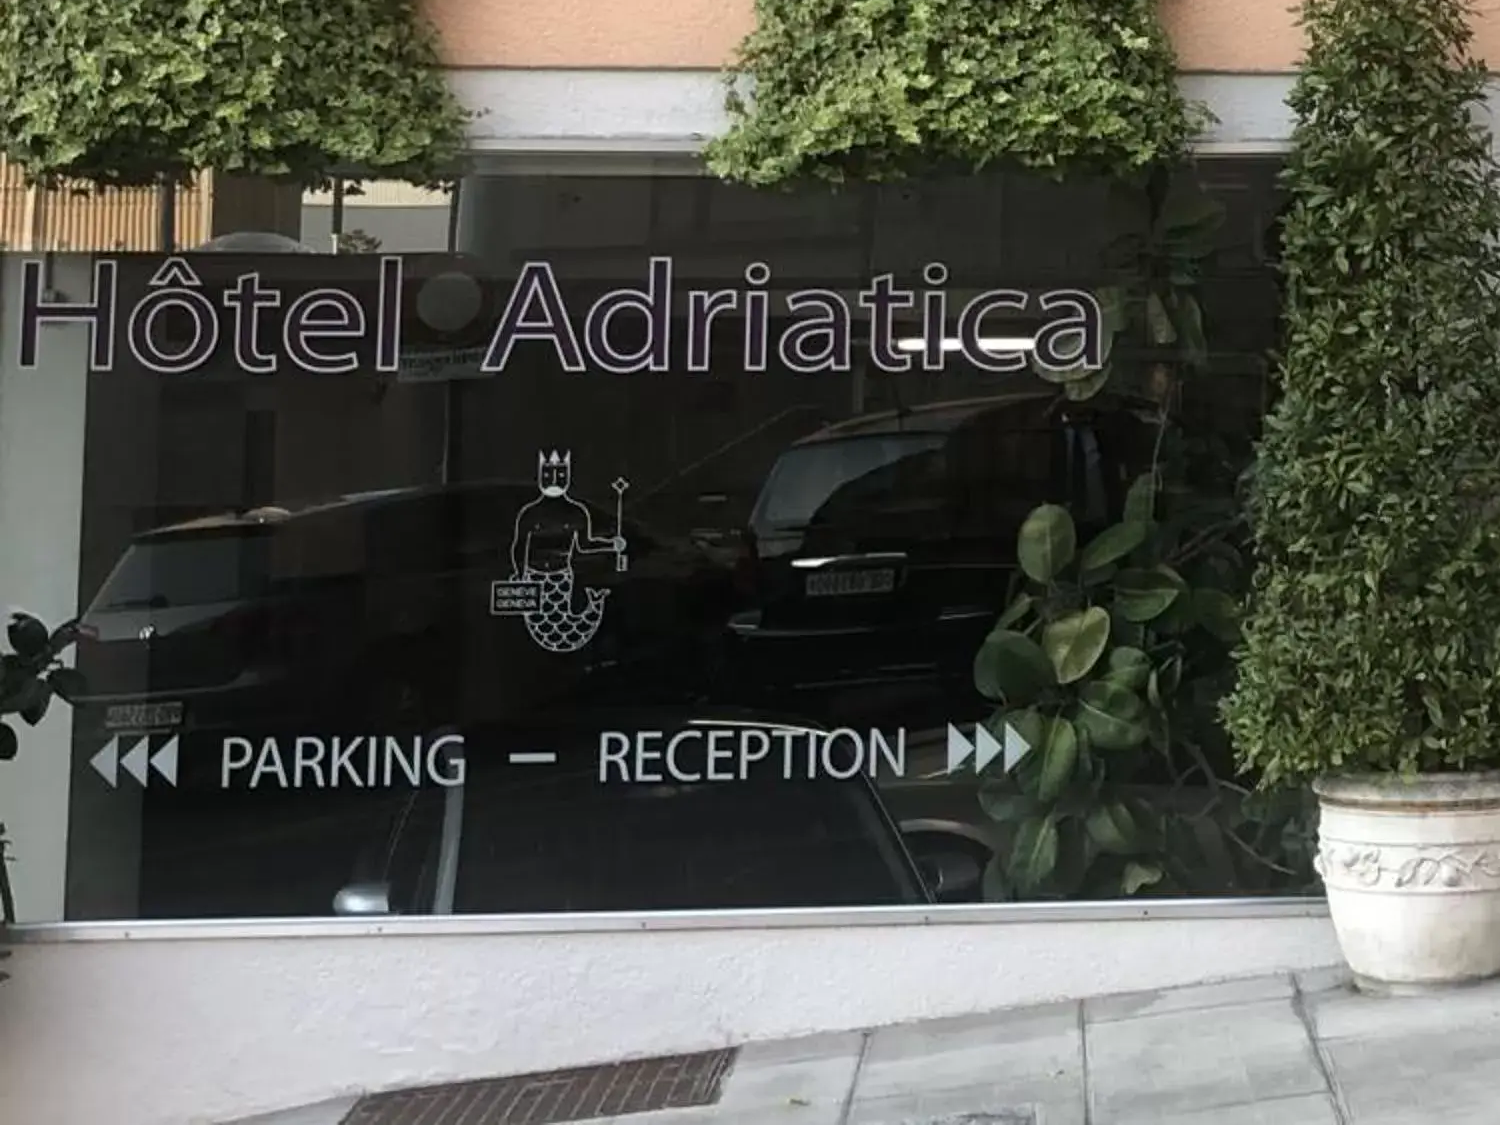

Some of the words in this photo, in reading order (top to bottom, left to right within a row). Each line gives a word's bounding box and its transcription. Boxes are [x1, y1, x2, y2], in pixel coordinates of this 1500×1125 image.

[18, 256, 402, 373] Hôtel
[480, 256, 1103, 373] Adriatica
[219, 733, 467, 789] PARKING
[599, 726, 905, 784] RECEPTION
